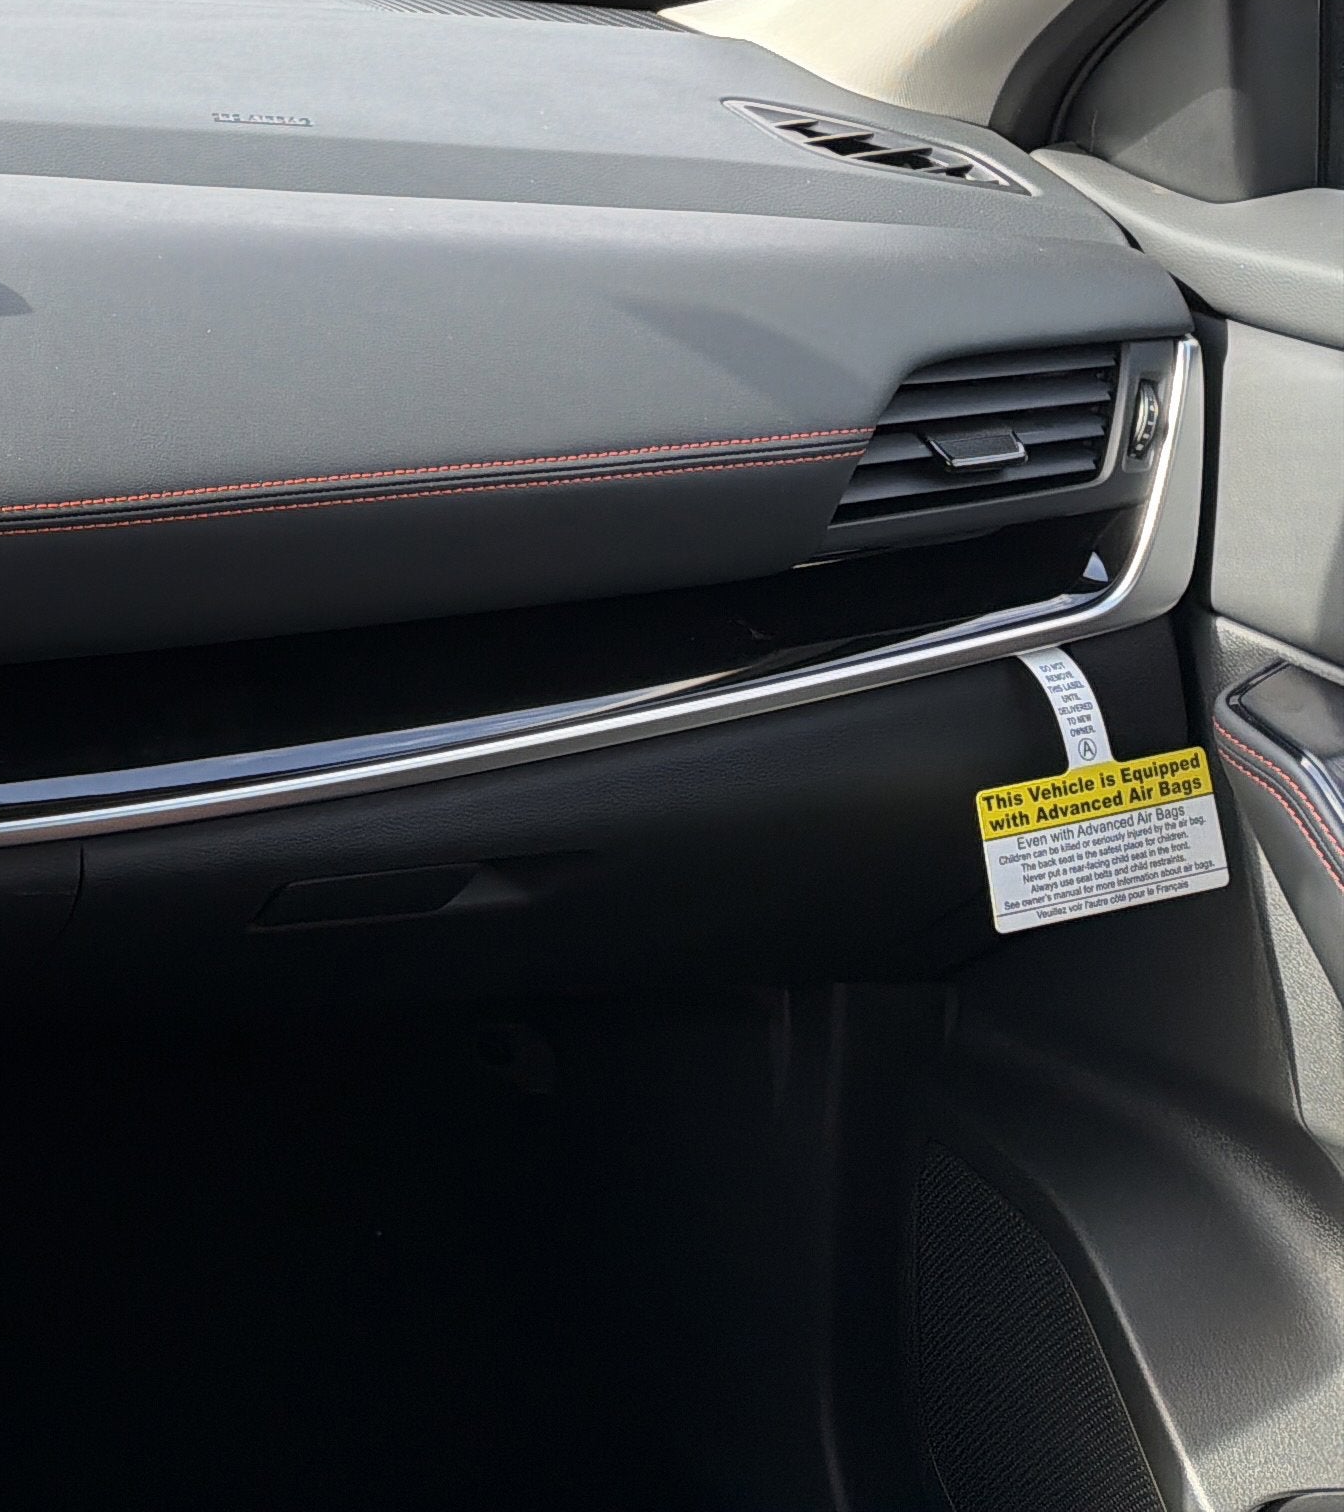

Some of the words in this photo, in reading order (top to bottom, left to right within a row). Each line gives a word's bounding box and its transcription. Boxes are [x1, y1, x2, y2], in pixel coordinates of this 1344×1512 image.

[981, 793, 1024, 813] This
[1026, 775, 1095, 804] Vehicle
[1098, 772, 1117, 789] is
[1119, 752, 1202, 786] Equipped
[988, 811, 1031, 833] with
[1035, 790, 1124, 825] Advanced
[1128, 785, 1154, 807] Air
[1158, 775, 1203, 800] Bags
[998, 852, 1032, 866] Children
[1032, 849, 1048, 859] can
[1048, 846, 1060, 856] be
[1060, 841, 1081, 853] killed
[1091, 831, 1126, 847] seriously
[1126, 826, 1153, 840] injured
[1153, 823, 1163, 835] by
[1164, 821, 1177, 831] the
[1189, 815, 1207, 826] bag.
[1016, 833, 1048, 851] Even
[1050, 828, 1075, 843] with
[1076, 813, 1135, 838] Advanced
[1136, 811, 1153, 826] Air
[1155, 805, 1186, 821] Bags
[1030, 881, 1059, 894] Always
[1059, 878, 1075, 888] use
[1075, 873, 1093, 885] seat
[1093, 868, 1113, 880] belts
[1114, 864, 1129, 875] and
[1130, 861, 1148, 873] child
[1149, 853, 1187, 869] restraints.
[1036, 907, 1068, 919] Veuillez
[1068, 902, 1084, 913] voir
[1128, 889, 1146, 902] pour
[1155, 879, 1189, 893] Français
